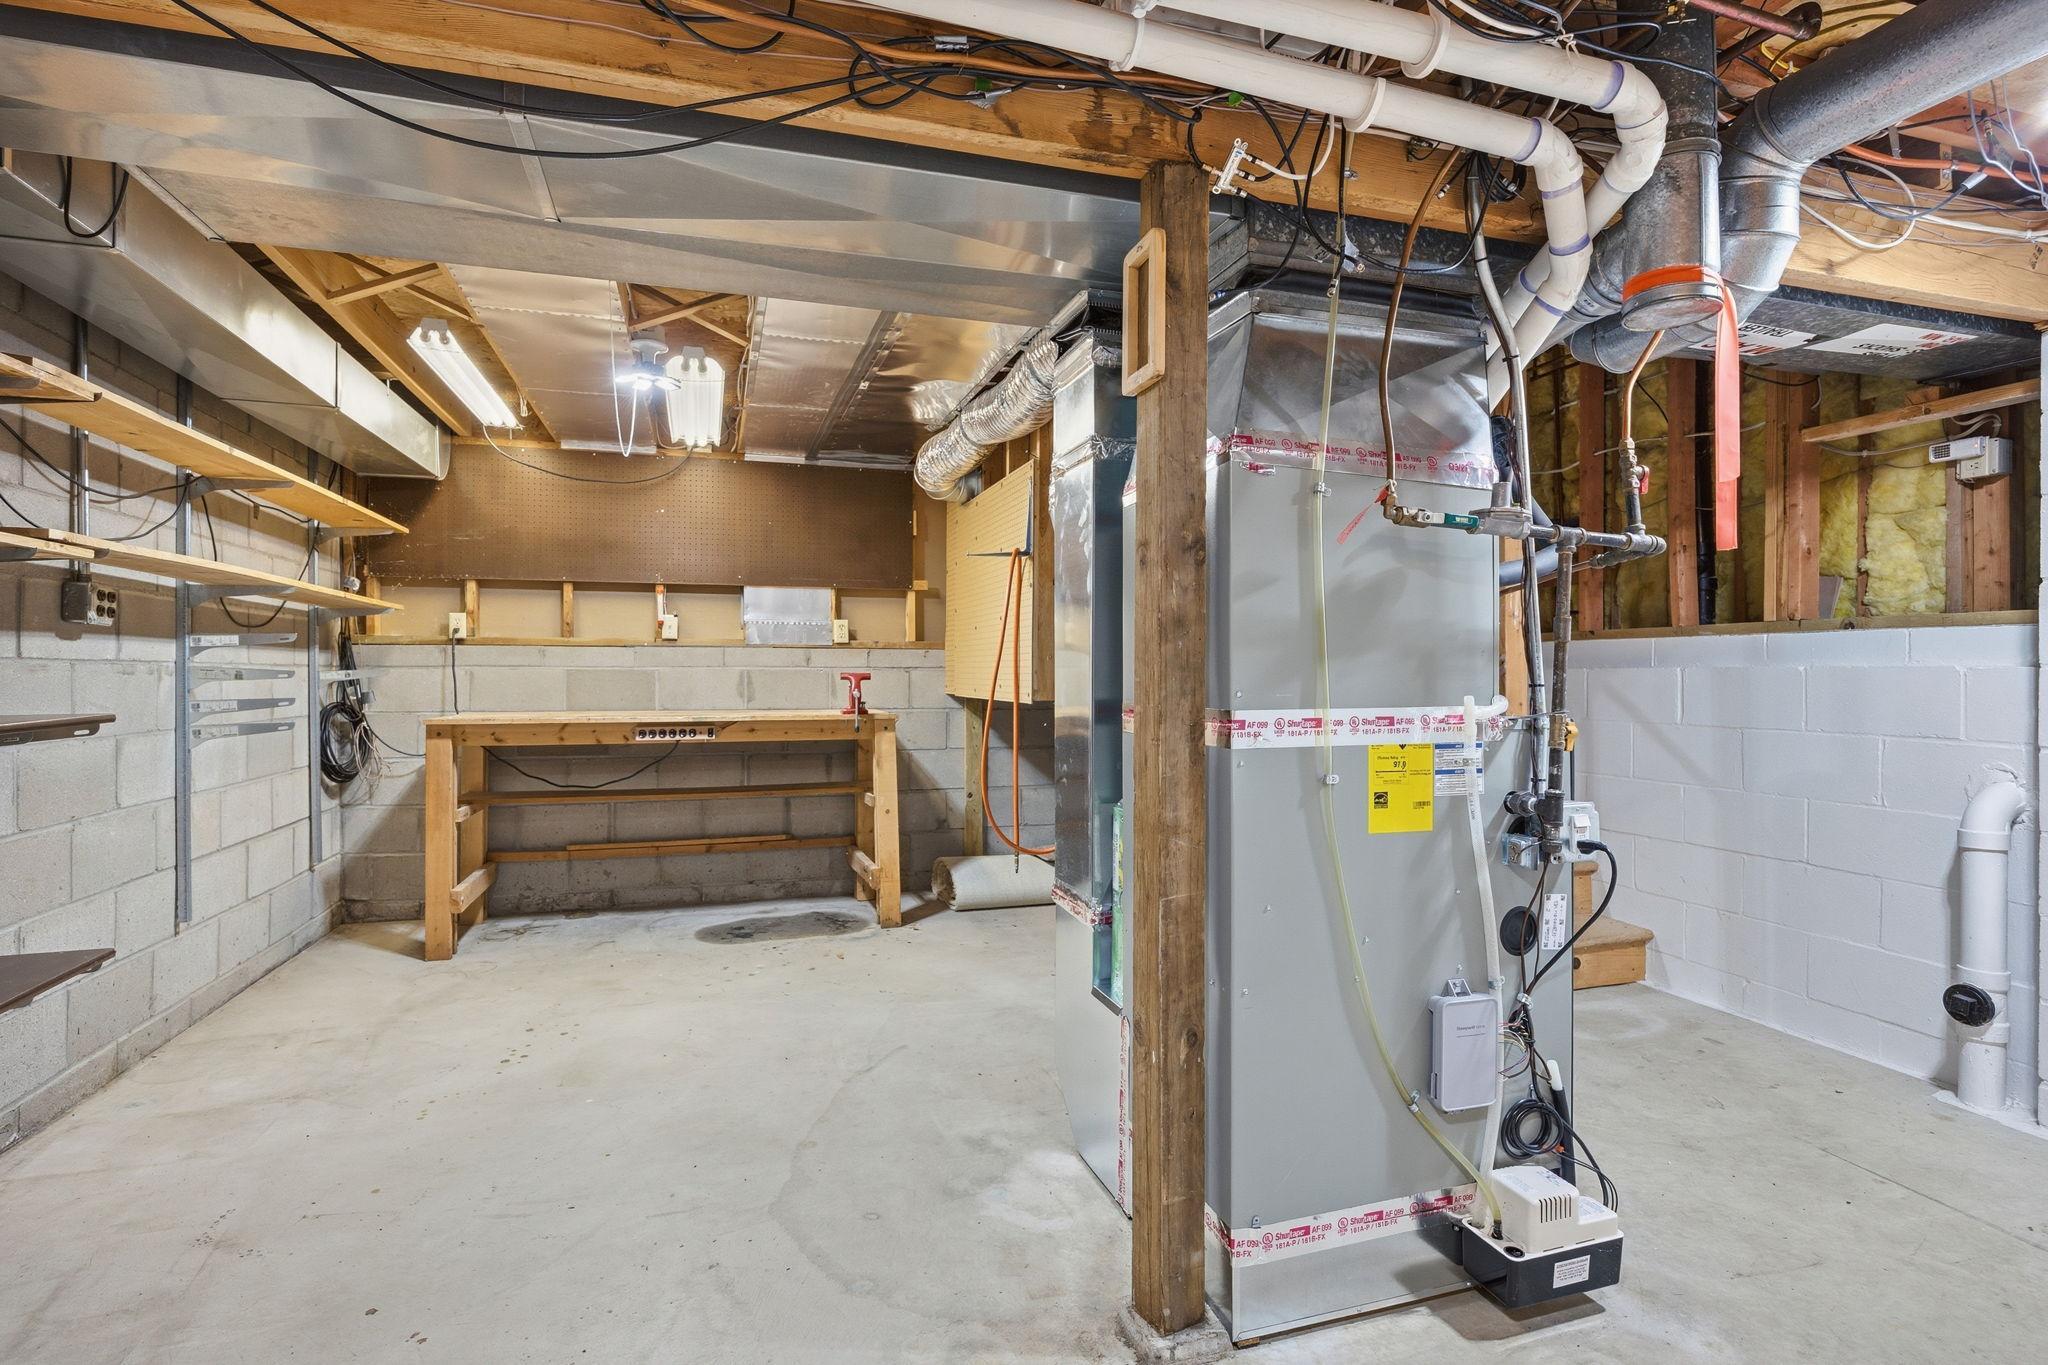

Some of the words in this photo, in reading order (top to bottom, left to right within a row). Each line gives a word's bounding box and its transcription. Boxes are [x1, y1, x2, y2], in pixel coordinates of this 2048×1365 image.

[1287, 718, 1322, 729] Shurtape
[1361, 716, 1395, 726] Shurtape
[1421, 1196, 1453, 1210] Shurtape
[1350, 1210, 1383, 1225] Shurtape
[1394, 1208, 1404, 1216] 099
[1275, 1225, 1310, 1241] Shurtape
[1322, 1223, 1332, 1232] 099
[1350, 1224, 1370, 1234] 181A-P
[1375, 1219, 1398, 1228] 181B-FX
[1247, 1240, 1259, 1248] 099
[1276, 1240, 1296, 1250] 181A-P
[1301, 1234, 1326, 1245] 181B-FX
